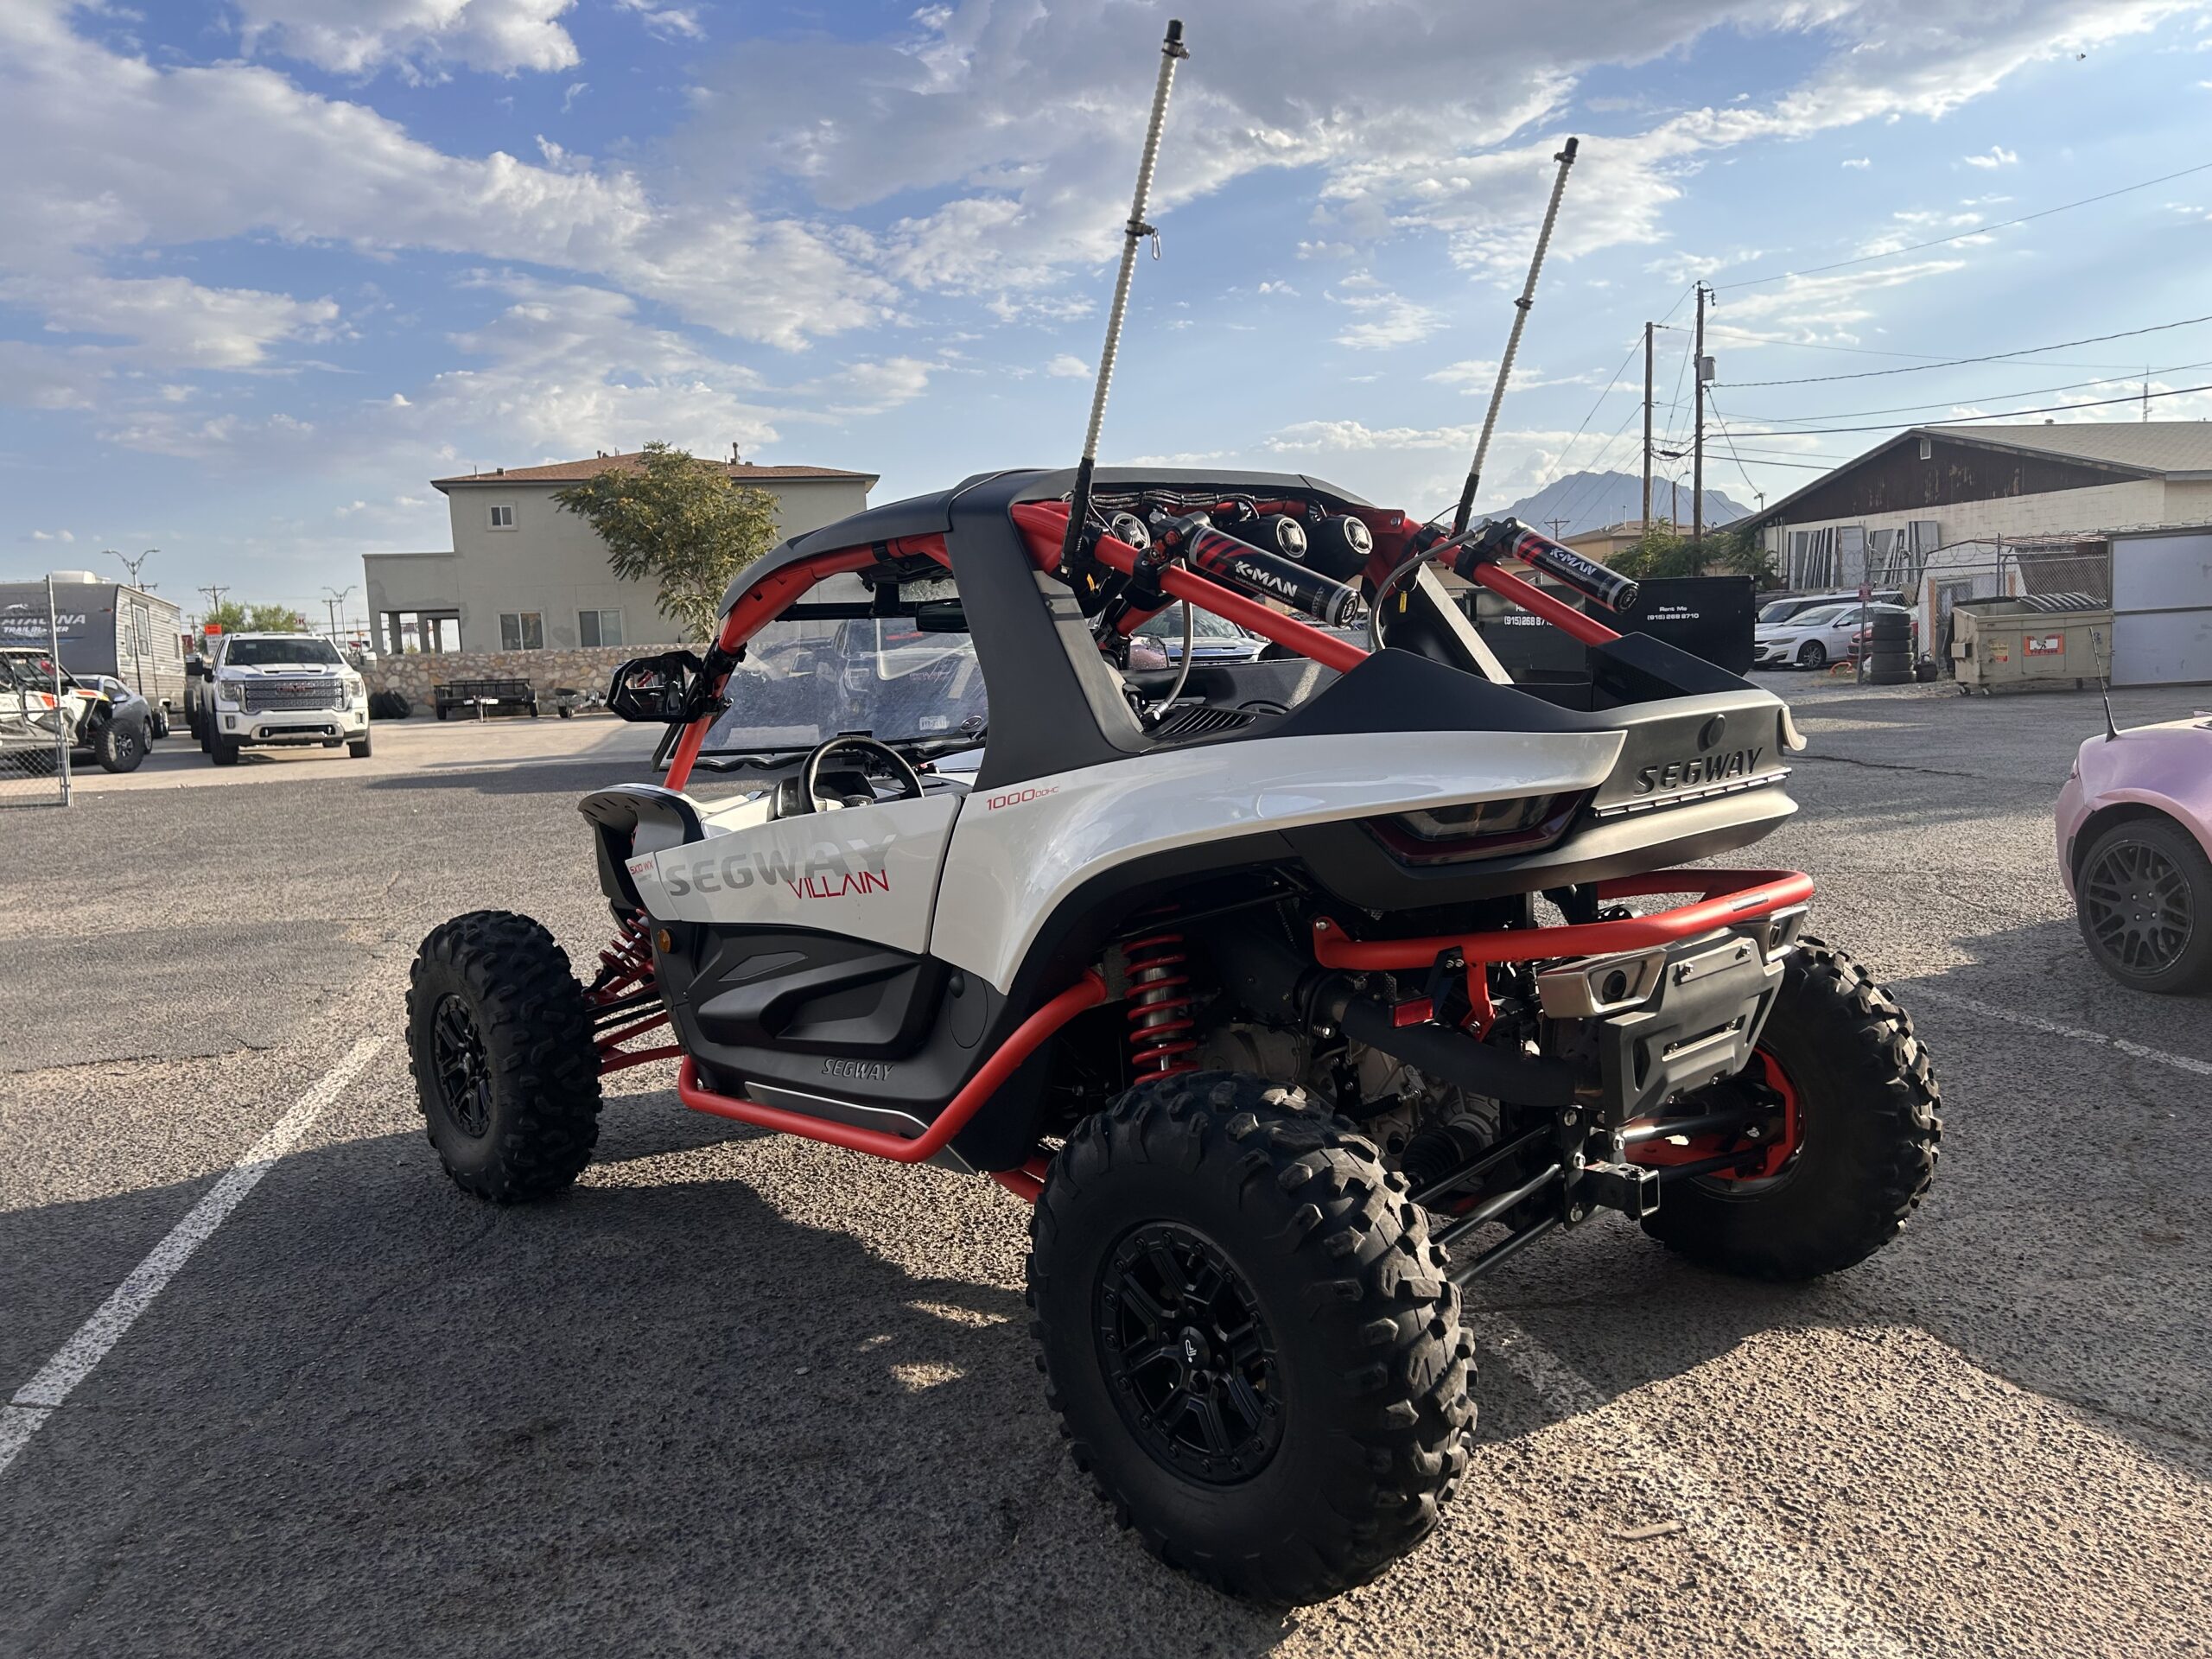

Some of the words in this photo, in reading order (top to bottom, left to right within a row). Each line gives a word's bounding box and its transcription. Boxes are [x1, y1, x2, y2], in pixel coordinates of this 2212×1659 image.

[1550, 547, 1598, 576] K-MAN
[1234, 560, 1298, 598] K-MAN
[1503, 615, 1521, 626] (915)
[1522, 616, 1535, 626] 268
[1632, 747, 1764, 798] SEGWAY
[665, 833, 897, 897] SEGWAY
[787, 868, 890, 899] VILLAIN
[821, 1058, 893, 1081] SEGWAY
